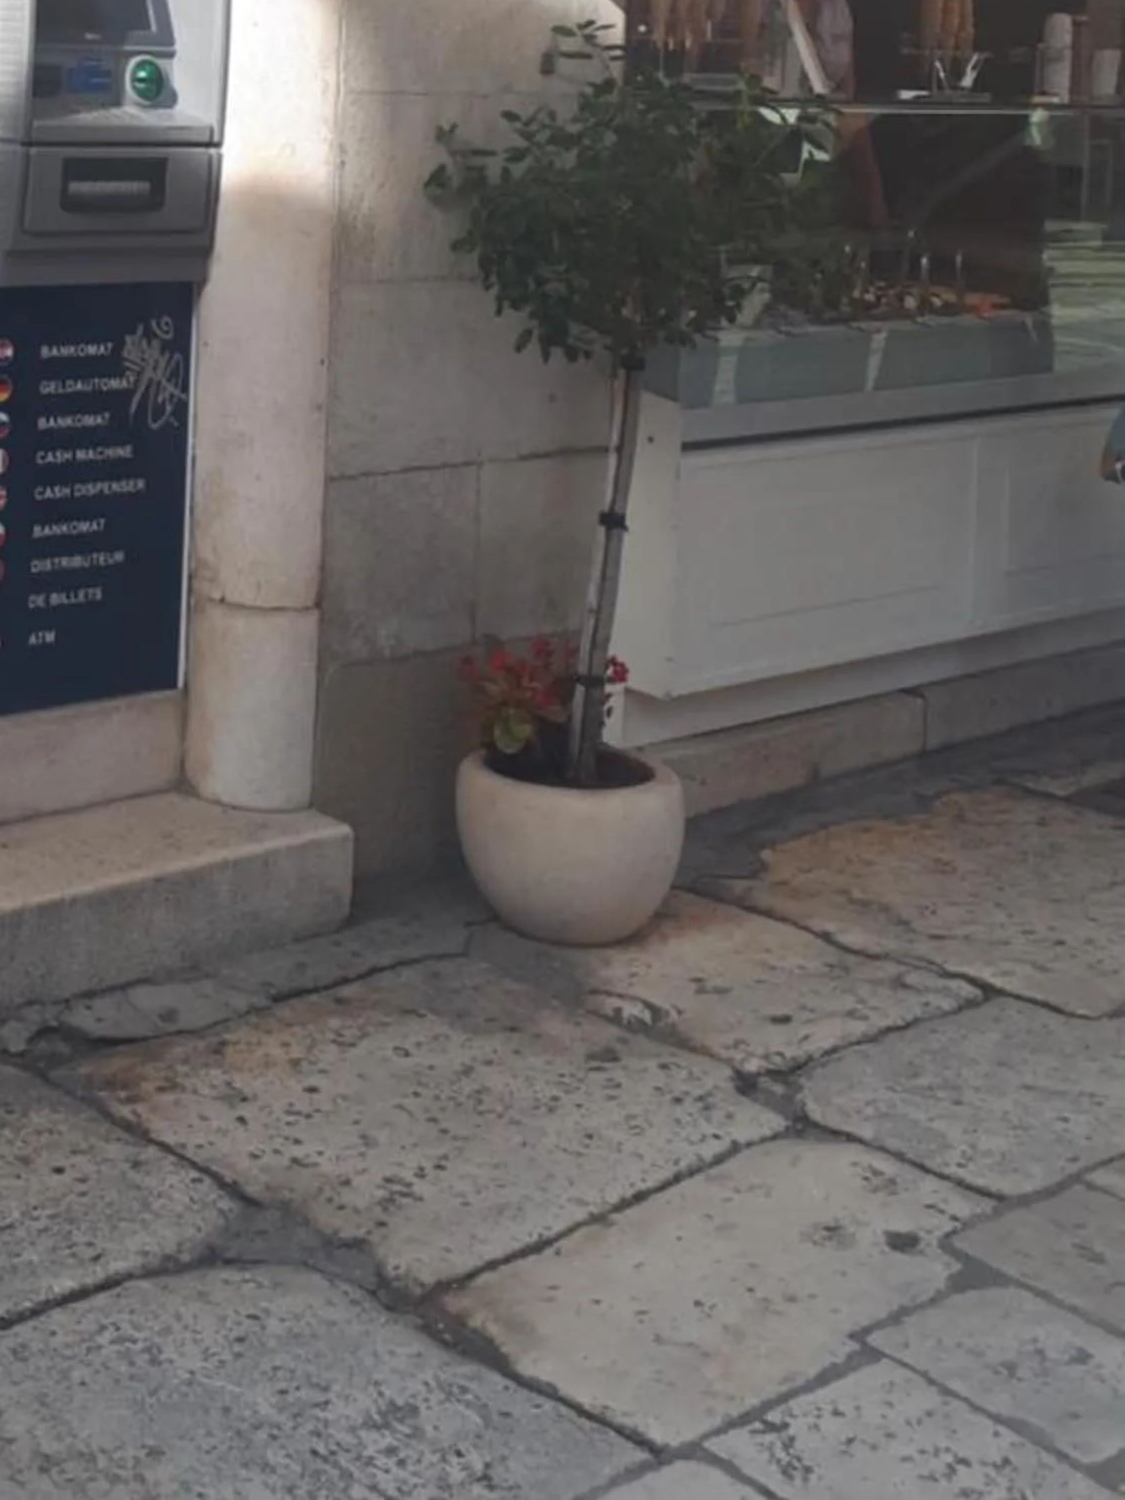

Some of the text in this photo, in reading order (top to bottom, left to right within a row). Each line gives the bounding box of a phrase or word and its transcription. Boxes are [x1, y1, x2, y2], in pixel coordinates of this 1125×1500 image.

[40, 341, 114, 360] BANKOMAT
[39, 375, 137, 396] GELDAUTOMAT
[37, 411, 111, 432] BANKOMAT
[35, 443, 134, 466] CASH MACHINE
[34, 478, 147, 502] CASH DISPENSER
[31, 518, 107, 539] BANKOMAT
[28, 629, 56, 646] ATM
